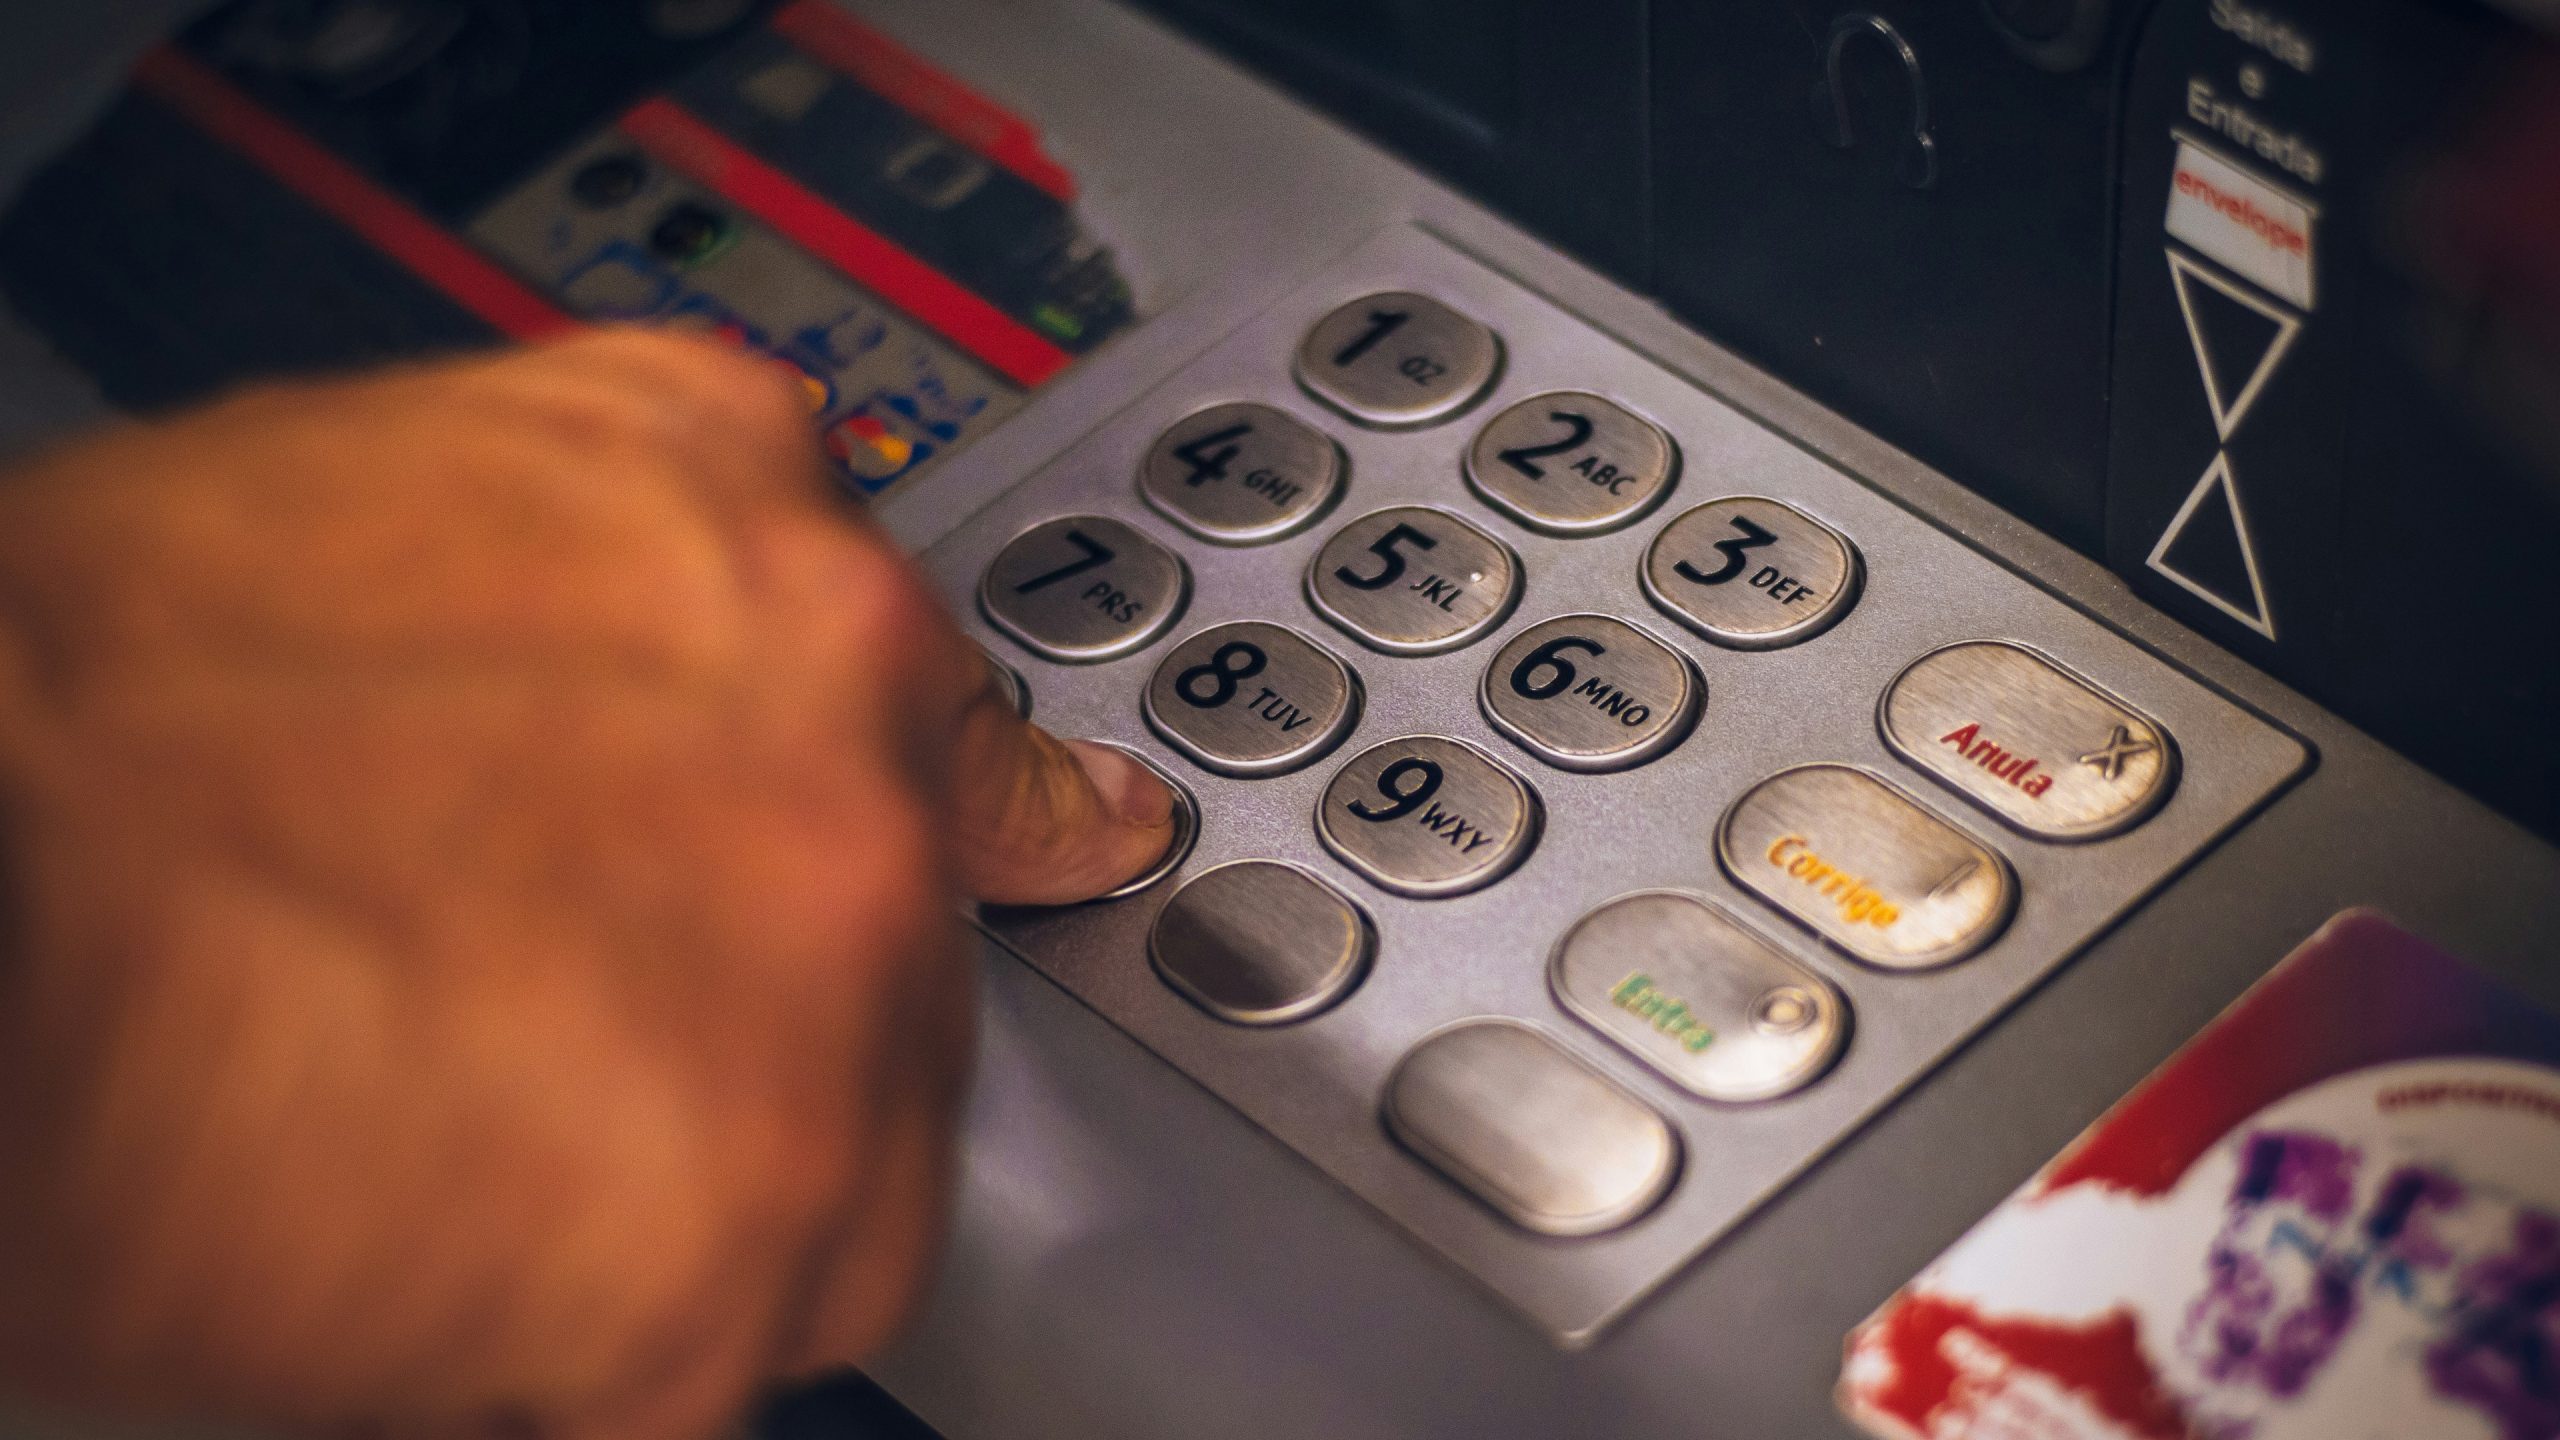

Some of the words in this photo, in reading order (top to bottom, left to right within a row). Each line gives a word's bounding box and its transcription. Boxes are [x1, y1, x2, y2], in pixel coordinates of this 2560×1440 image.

[2240, 65, 2263, 98] e
[2188, 79, 2320, 182] Entrada
[2174, 170, 2304, 256] envelope
[1332, 311, 1408, 367] 1
[1172, 422, 1253, 488] 4
[1244, 469, 1302, 507] GHI
[1497, 412, 1593, 481] 2
[1570, 456, 1636, 496] ABC
[1014, 530, 1116, 595] 7
[1081, 580, 1142, 623] PRS
[1334, 522, 1438, 591] 5
[1410, 574, 1463, 612] JKL
[1673, 515, 1778, 585] 3
[1748, 566, 1814, 604] DEF
[1175, 641, 1267, 708] 8
[1248, 687, 1312, 732] TUV
[1510, 635, 1605, 700] 6
[1572, 676, 1651, 727] MNO
[1347, 757, 1443, 822] 9
[1420, 802, 1493, 853] WXY
[1940, 723, 2053, 798] Anula
[1768, 834, 1899, 929] Corrige
[1610, 970, 1715, 1053] Entra
